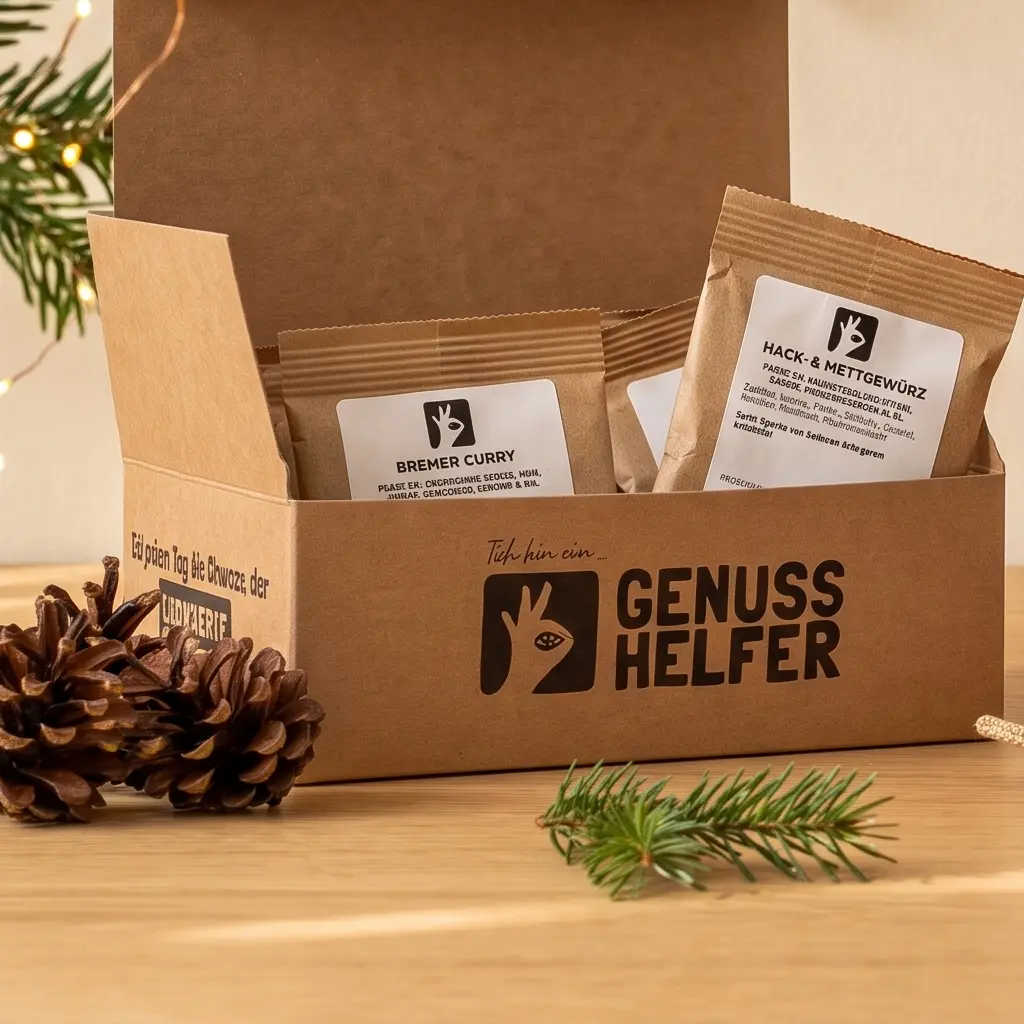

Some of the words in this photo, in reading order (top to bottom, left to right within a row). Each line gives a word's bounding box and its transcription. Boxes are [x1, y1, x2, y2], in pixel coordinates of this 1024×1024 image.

[763, 341, 809, 364] HACK-
[810, 356, 820, 369] &
[824, 360, 927, 400] METTGEWÜRZ
[790, 426, 804, 436] von
[396, 454, 460, 473] BREMER
[464, 450, 515, 466] CURRY
[524, 537, 558, 564] hin
[250, 567, 269, 600] der
[616, 559, 846, 630] GENUSS
[615, 619, 841, 691] HELFER
